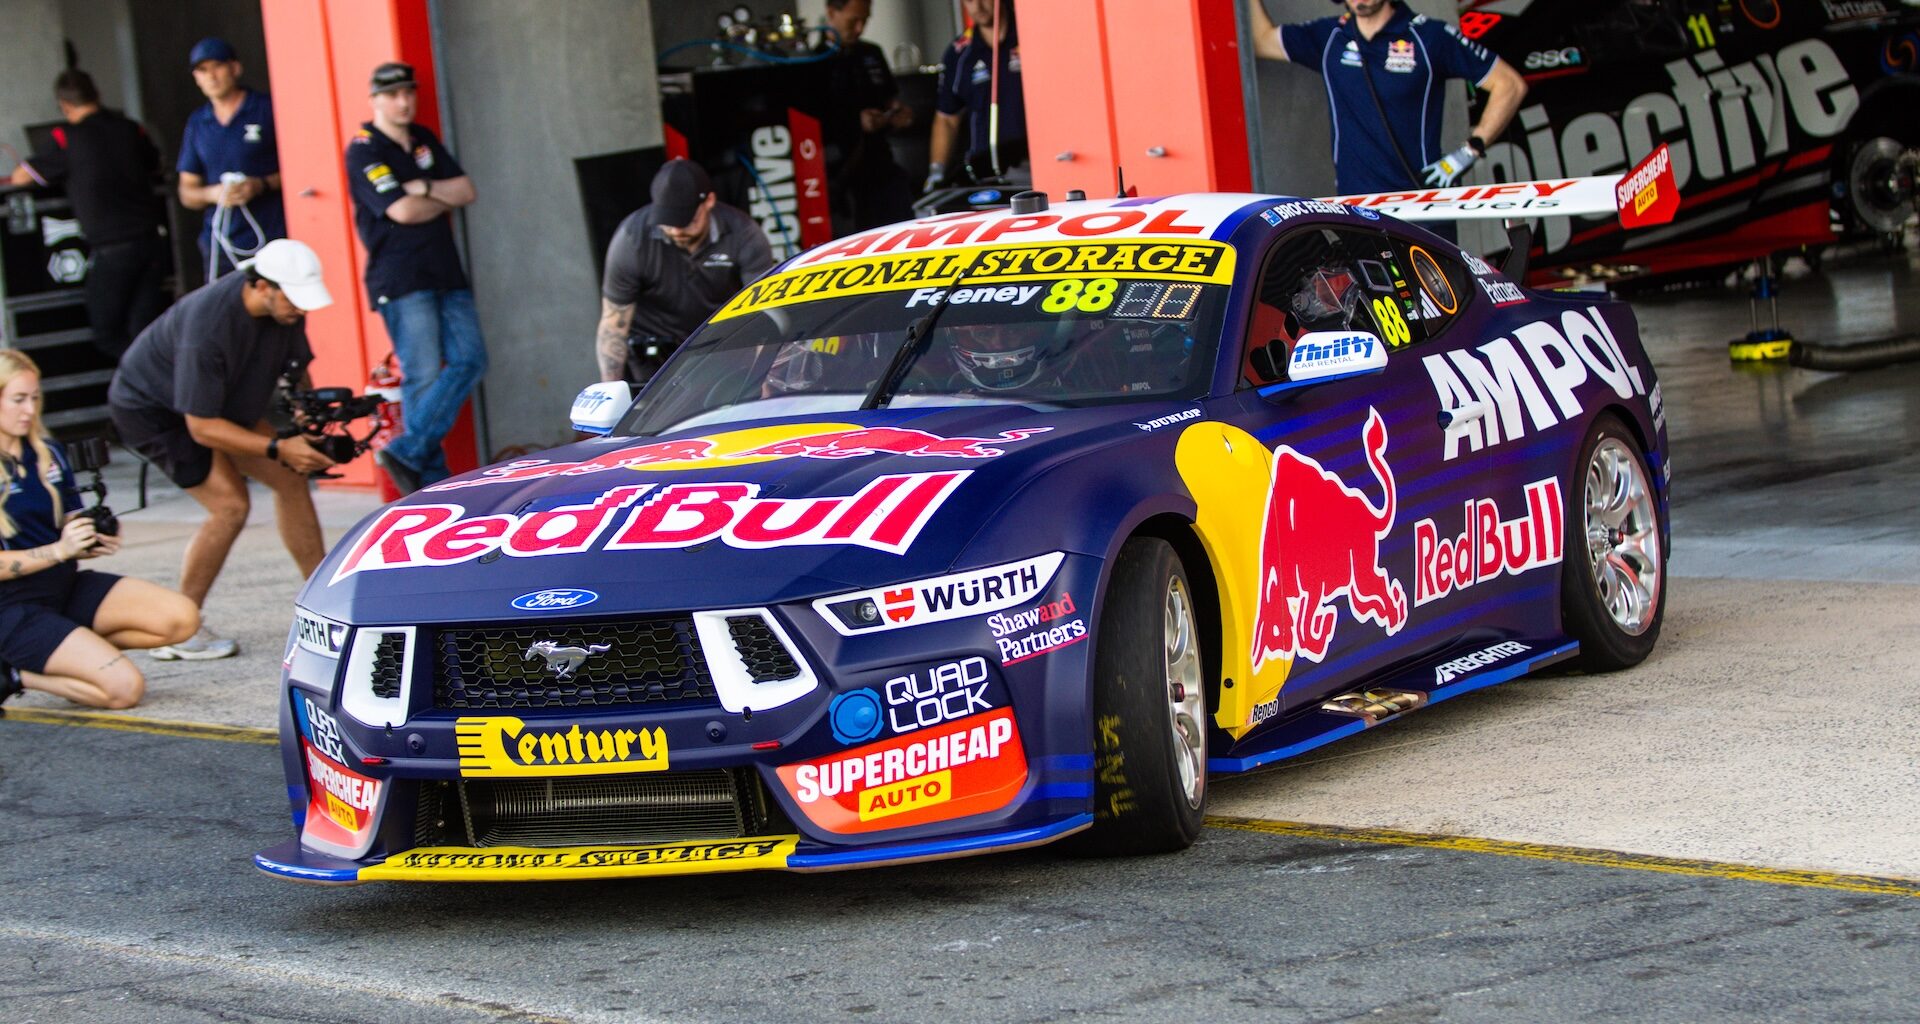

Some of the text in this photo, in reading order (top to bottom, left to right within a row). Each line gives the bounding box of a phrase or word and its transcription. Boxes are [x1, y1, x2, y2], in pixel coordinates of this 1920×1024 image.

[1687, 13, 1716, 48] 11
[1318, 179, 1579, 206] MPLIFY
[1617, 147, 1669, 209] SUPERCHEAP
[1273, 200, 1350, 220] BROC FEENEY
[1637, 187, 1656, 211] AUTO
[800, 209, 1205, 265] AMPOL
[732, 244, 1217, 311] NATIONAL STORAGE
[905, 278, 1119, 313] Feeney 88
[1477, 278, 1526, 304] Partners
[1372, 295, 1411, 347] 88
[1293, 336, 1374, 363] Thrifty
[1294, 356, 1355, 370] CAR RENTAL
[1422, 306, 1646, 462] AMPOL
[1147, 407, 1202, 429] DUNLOP
[525, 590, 582, 609] Ford
[921, 564, 1039, 613] WÜRTH
[296, 615, 327, 647] ÜRTH
[995, 618, 1088, 663] Partners
[885, 656, 988, 704] QUAD
[1436, 641, 1533, 685] FREIGHTER
[305, 698, 340, 742] QUAD
[888, 682, 994, 733] LOCK
[1252, 699, 1279, 724] Repco
[310, 723, 350, 768] LOCK
[455, 716, 670, 777] Century
[795, 717, 1013, 803] SUPERCHEAP
[330, 801, 354, 827] AUTO
[868, 780, 942, 813] AUTO
